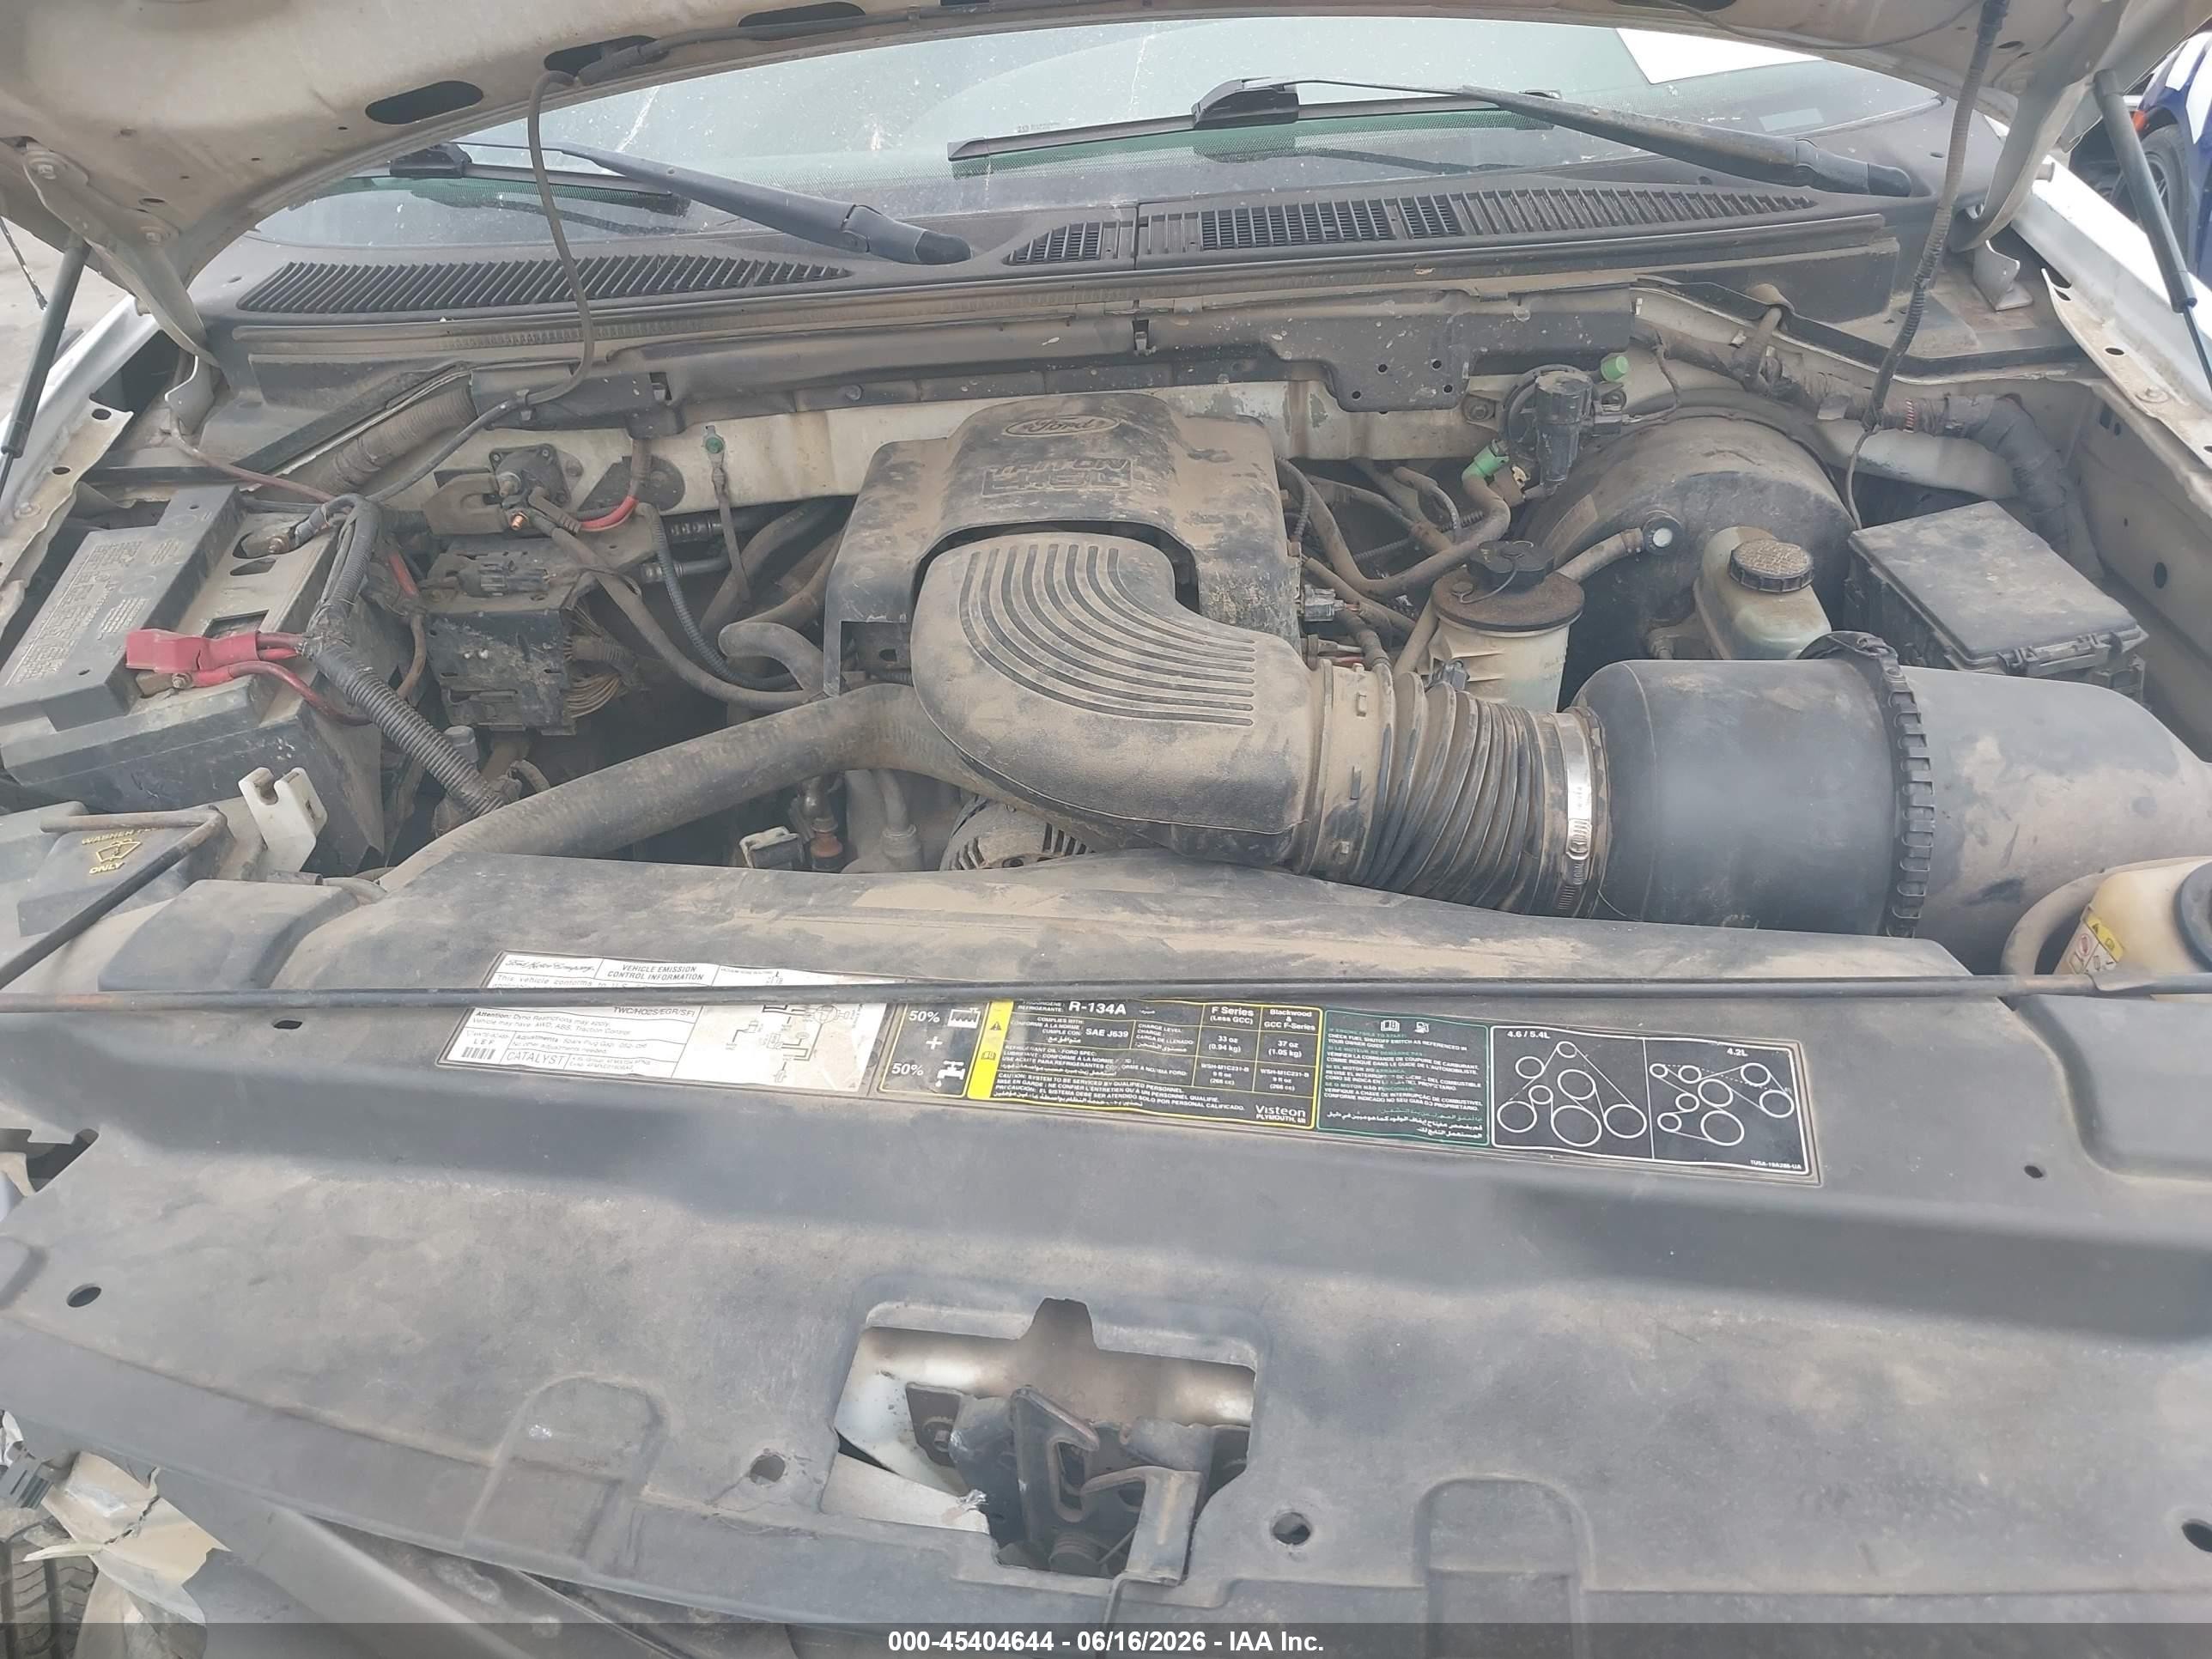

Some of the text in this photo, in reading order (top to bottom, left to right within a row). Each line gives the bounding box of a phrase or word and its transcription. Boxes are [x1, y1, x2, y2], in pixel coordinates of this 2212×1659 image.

[1025, 417, 1097, 433] Ford
[89, 861, 125, 874] ONLY
[622, 963, 697, 975] VEHICLE EMISSION
[607, 970, 705, 981] CONTROL INFORMATION
[1068, 1000, 1127, 1016] R-134A
[1220, 1007, 1255, 1018] Series
[1269, 1009, 1313, 1018] Blackwood
[476, 1011, 512, 1019] Attention:
[908, 1010, 941, 1023] 50%
[1231, 1017, 1254, 1026] GCC)
[1085, 1028, 1129, 1038] SAE J639
[1283, 1023, 1316, 1032] F-Series
[1529, 1030, 1551, 1039] 5.4L
[1208, 1043, 1242, 1054] (0.94 kg)
[1422, 1040, 1460, 1051] REFERENCED
[1042, 1053, 1076, 1061] CONFORME
[1267, 1048, 1288, 1057] (1.05
[1726, 1047, 1749, 1057] 4.2L
[507, 1051, 564, 1066] CATALYST
[1405, 1056, 1433, 1065] COUPURE
[891, 1061, 924, 1076] 50%
[1439, 1079, 1482, 1088] COMBUSTIBLE
[1057, 1083, 1085, 1091] CONFIER
[1151, 1091, 1188, 1100] PERSONNEL
[1170, 1098, 1206, 1108] PERSONAL
[1206, 1102, 1245, 1111] CALIFICADO.
[1255, 1103, 1306, 1118] Visteon
